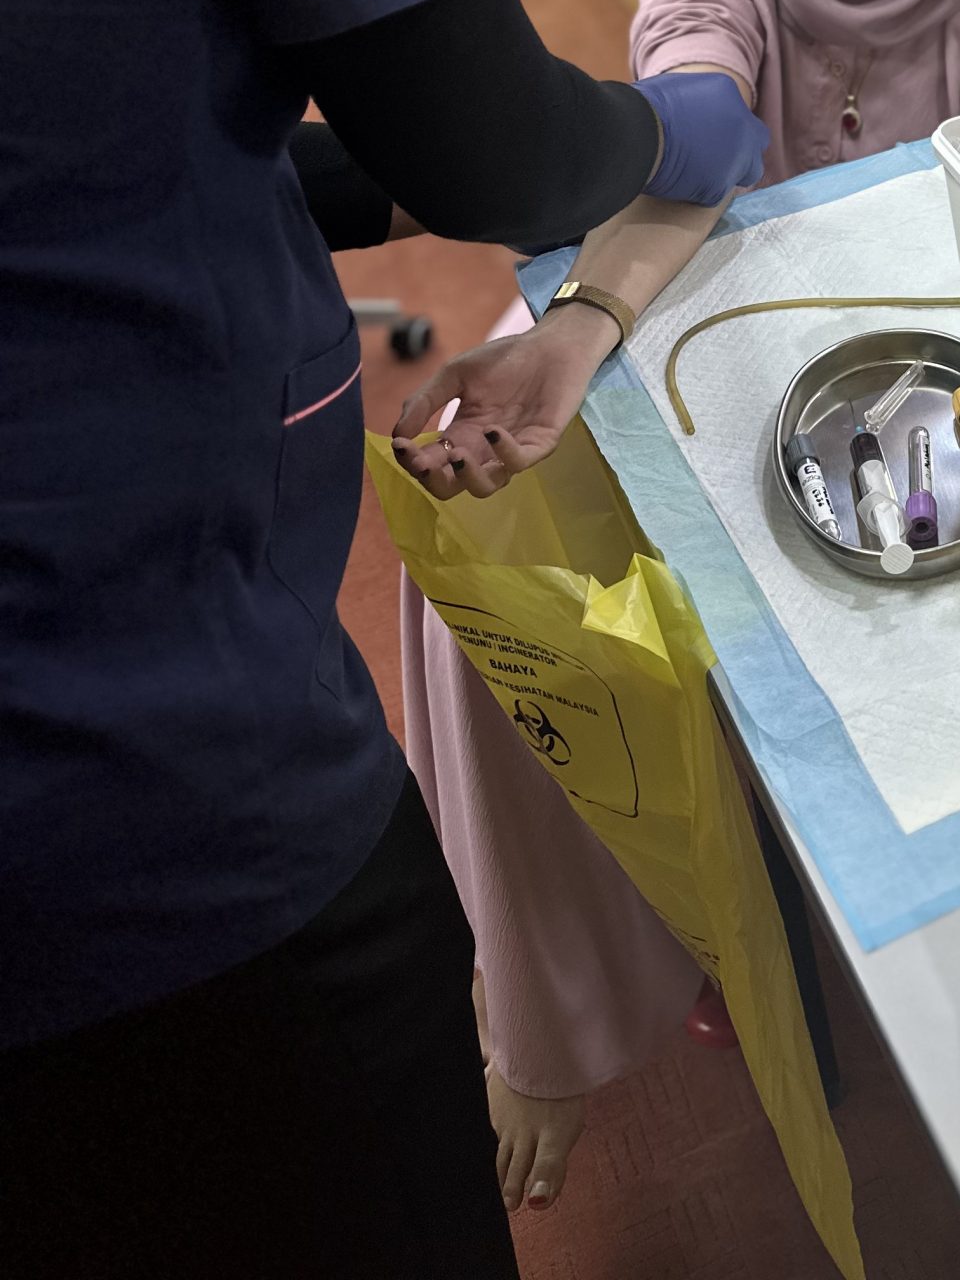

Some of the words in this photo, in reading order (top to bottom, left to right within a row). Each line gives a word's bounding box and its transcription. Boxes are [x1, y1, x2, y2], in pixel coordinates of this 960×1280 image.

[482, 630, 513, 644] UNTUK
[498, 644, 558, 667] INCINERATOR
[489, 658, 538, 678] BAHAYA
[505, 683, 554, 701] KESIHATAN
[555, 695, 599, 717] MALAYSIA
